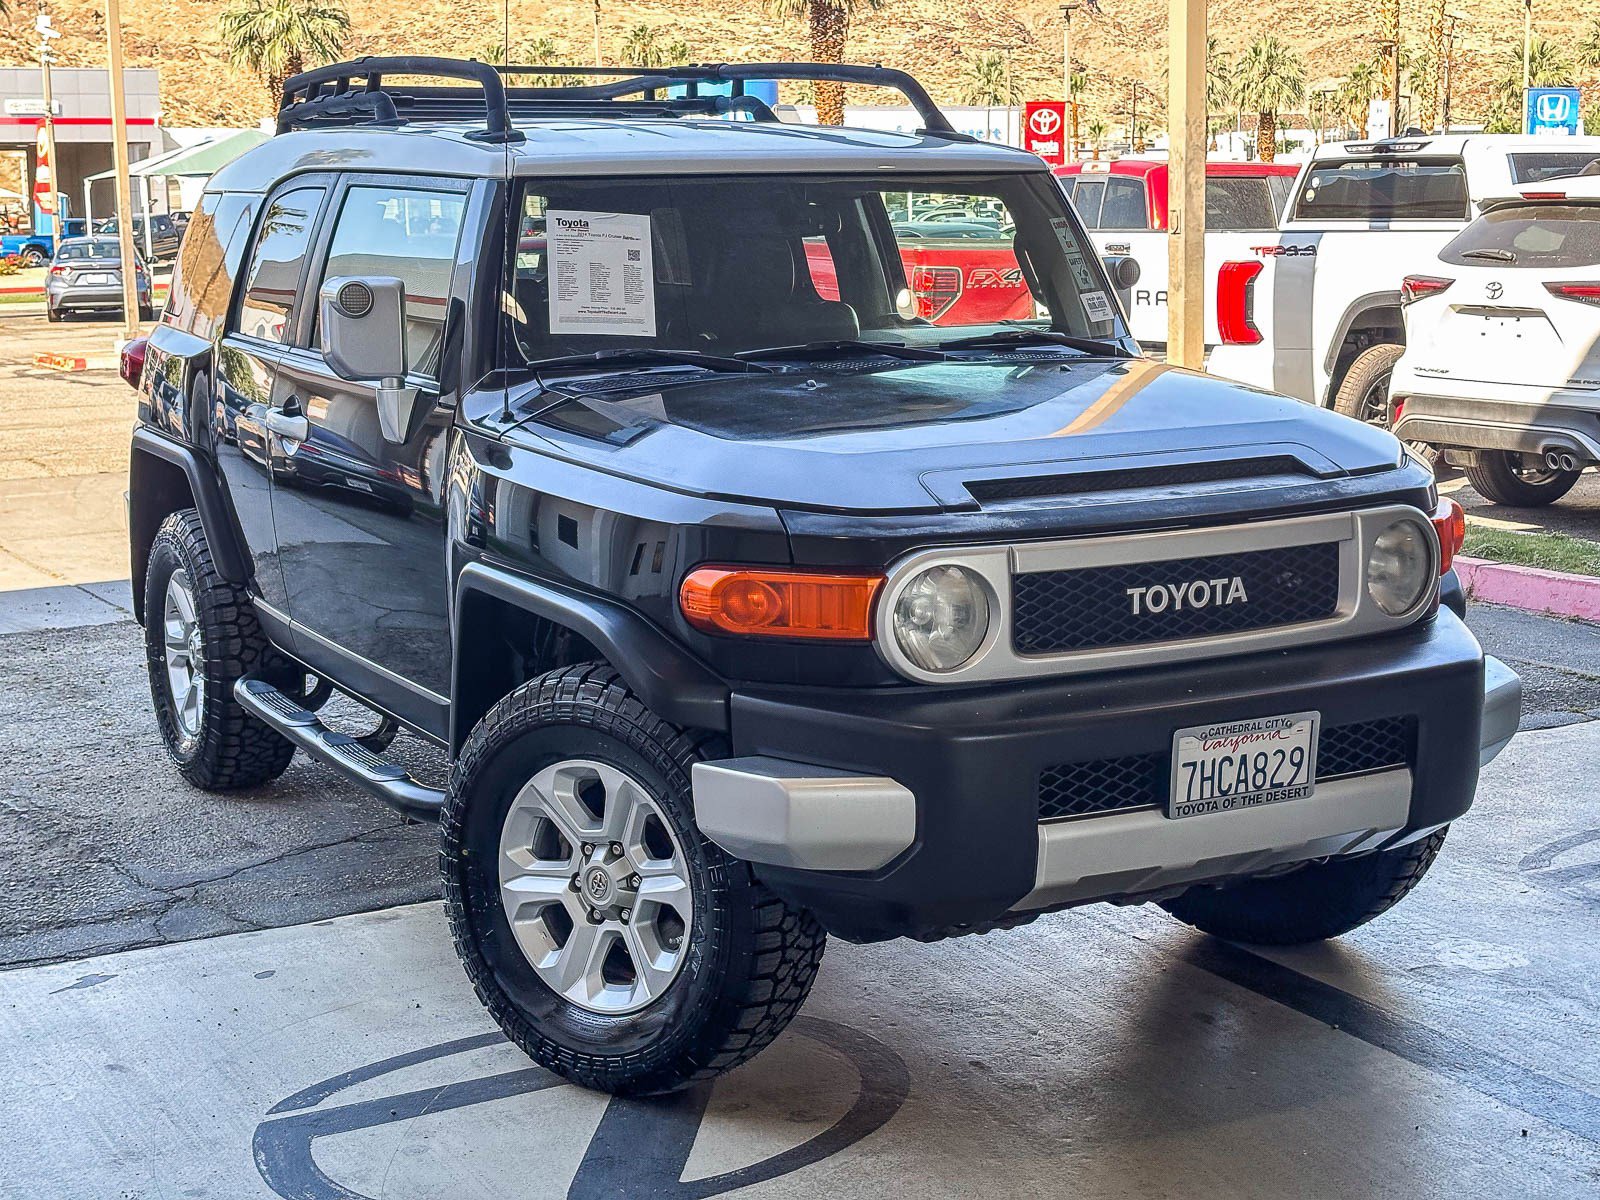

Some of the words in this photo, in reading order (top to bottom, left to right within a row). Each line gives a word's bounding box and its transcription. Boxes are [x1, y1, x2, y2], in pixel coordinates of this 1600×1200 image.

[556, 218, 589, 228] Toyota
[967, 268, 1022, 284] FX4
[1127, 576, 1248, 614] TOYOTA
[1208, 722, 1262, 737] CATHEDRAL
[1265, 718, 1286, 729] CITY
[1202, 729, 1290, 753] California
[1182, 746, 1305, 802] 7HCA829
[1176, 801, 1218, 816] TOYOTA
[1222, 798, 1237, 808] OF
[1241, 794, 1262, 805] THE
[1266, 786, 1308, 800] DESERT
